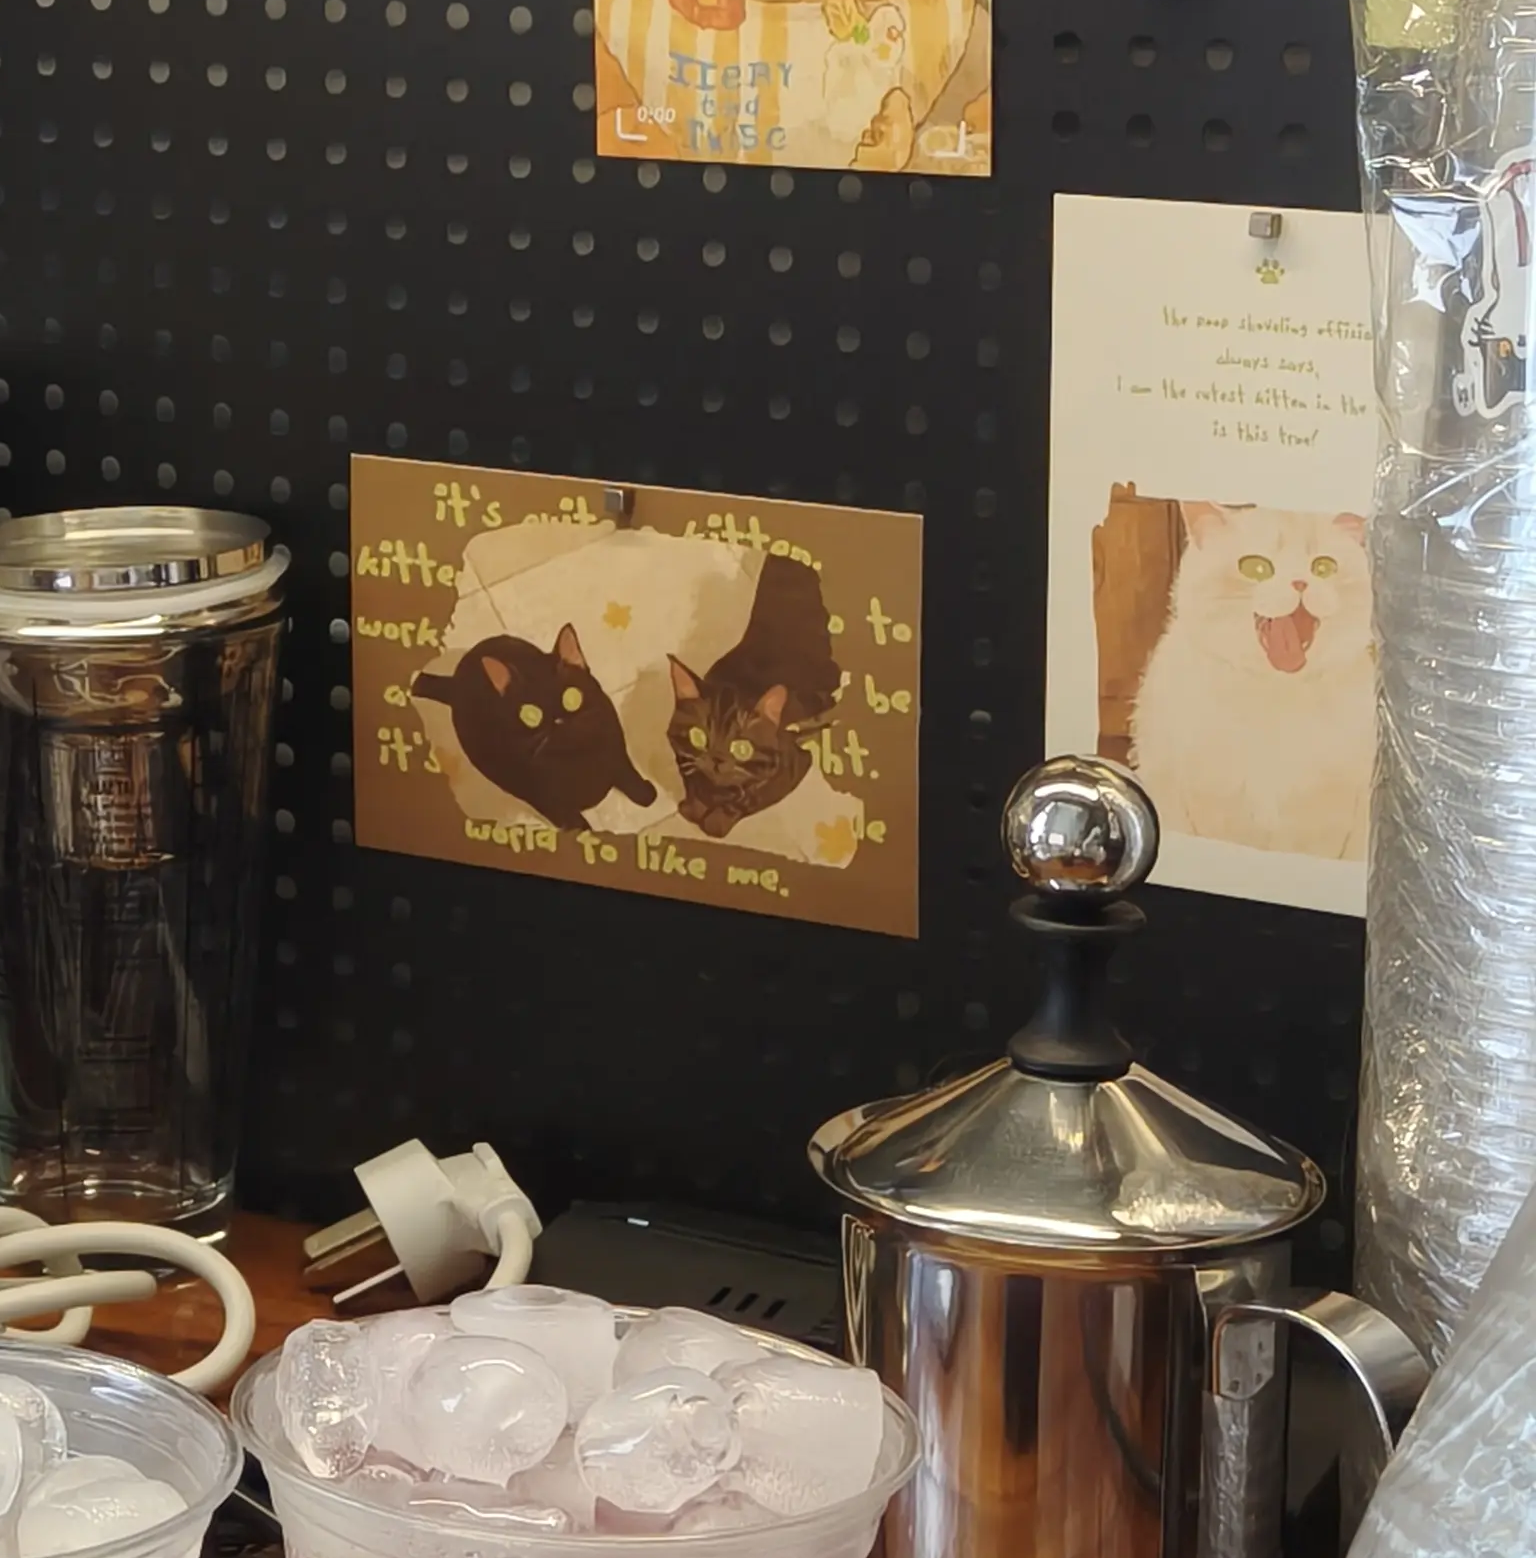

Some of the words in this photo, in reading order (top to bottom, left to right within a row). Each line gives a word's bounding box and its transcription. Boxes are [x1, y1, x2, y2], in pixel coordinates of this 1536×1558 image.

[1216, 347, 1269, 370] always
[1162, 378, 1187, 400] the
[1194, 381, 1246, 404] cutest
[1254, 383, 1307, 410] kitten
[1340, 394, 1367, 416] the
[1213, 420, 1227, 438] is
[1237, 421, 1269, 443] this
[434, 482, 502, 528] it's
[865, 596, 912, 645] to
[864, 673, 912, 714] be
[577, 829, 619, 864] to
[637, 831, 707, 879] like
[727, 865, 790, 897] me.
